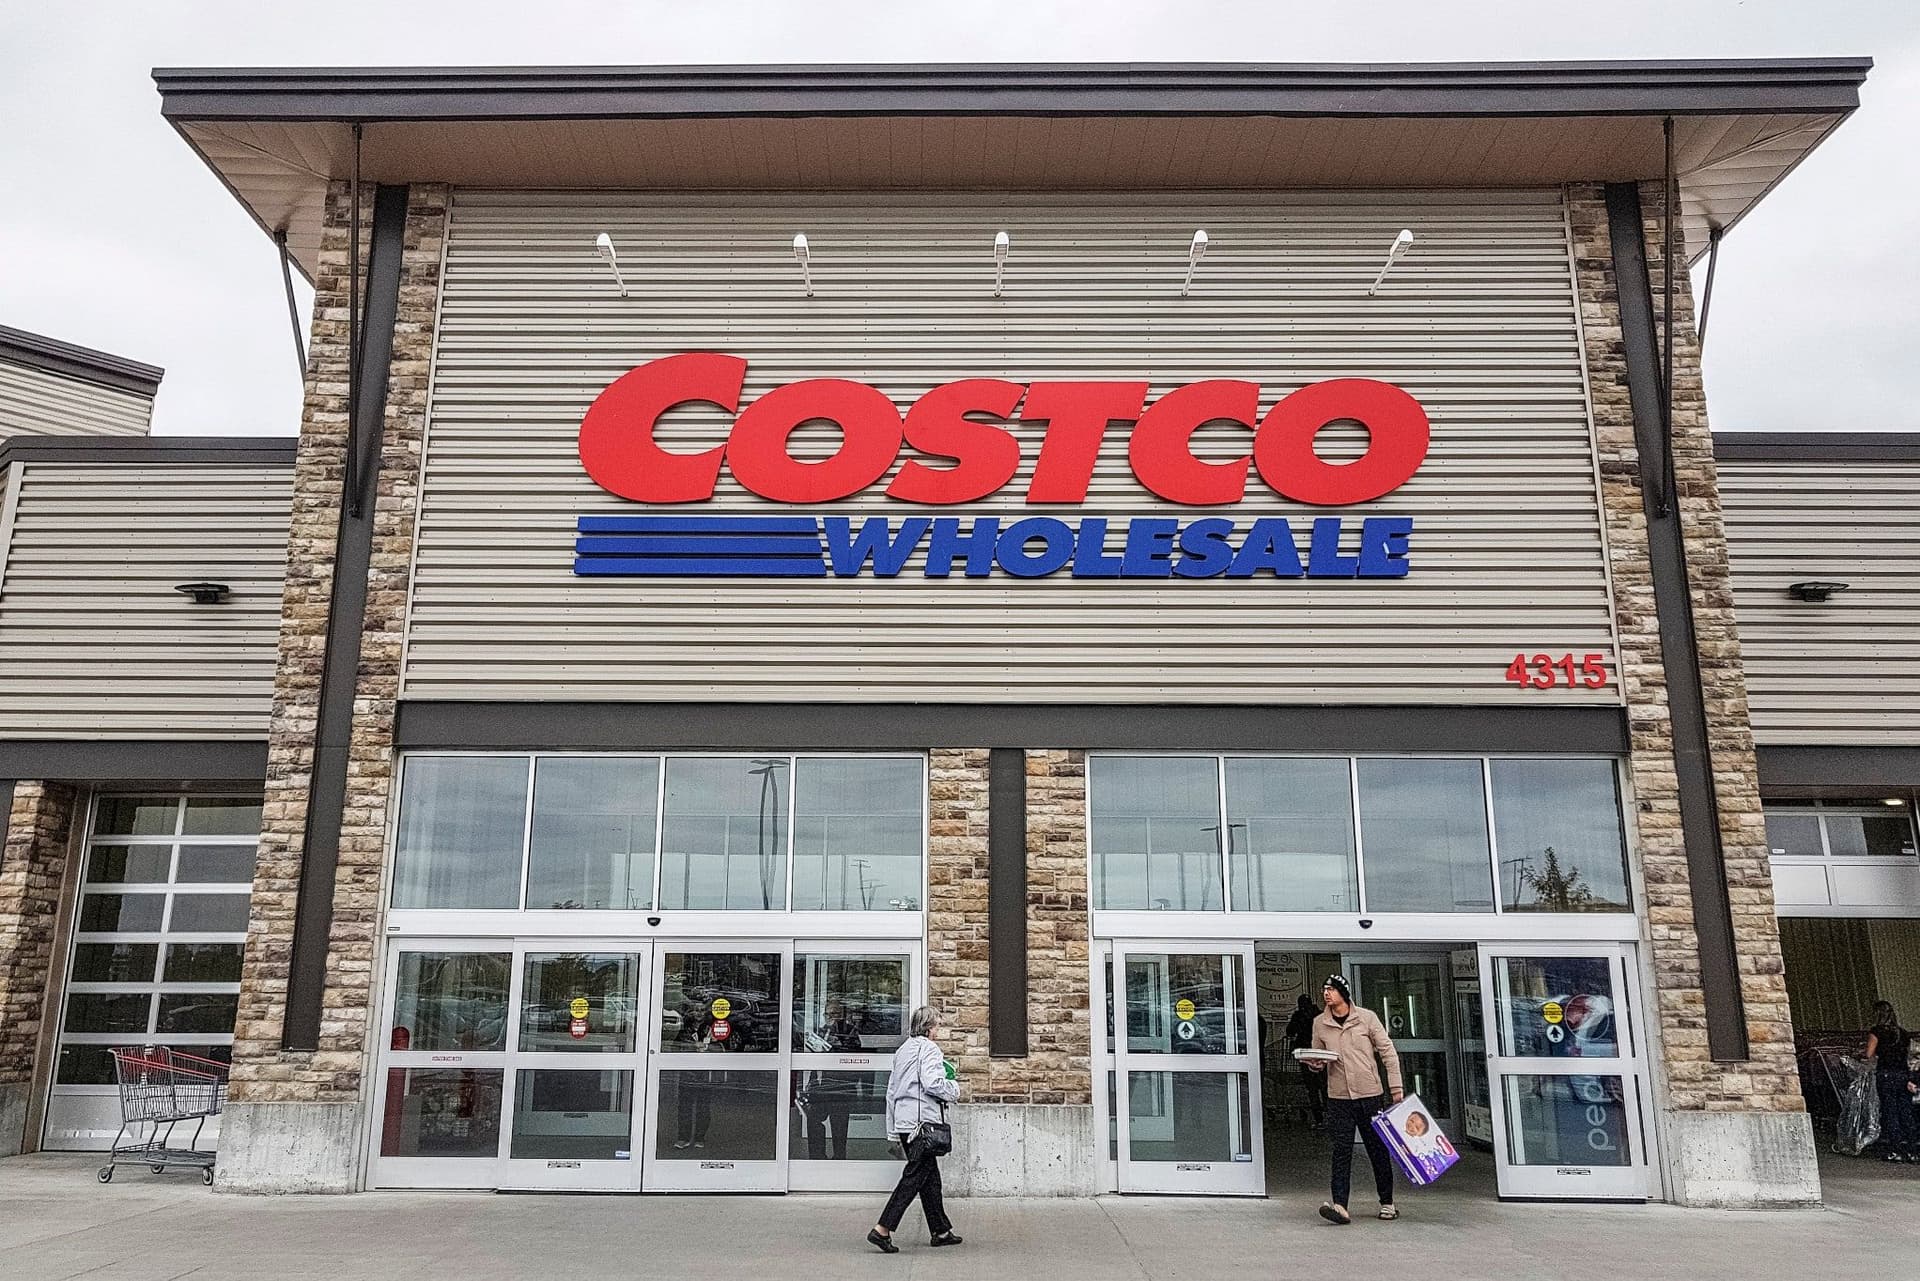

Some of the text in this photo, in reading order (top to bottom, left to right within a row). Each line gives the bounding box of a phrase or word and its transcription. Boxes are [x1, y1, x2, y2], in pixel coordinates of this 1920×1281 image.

[577, 351, 1431, 506] COSTCO
[823, 516, 1413, 578] WHOLESALE
[1505, 653, 1607, 689] 4315
